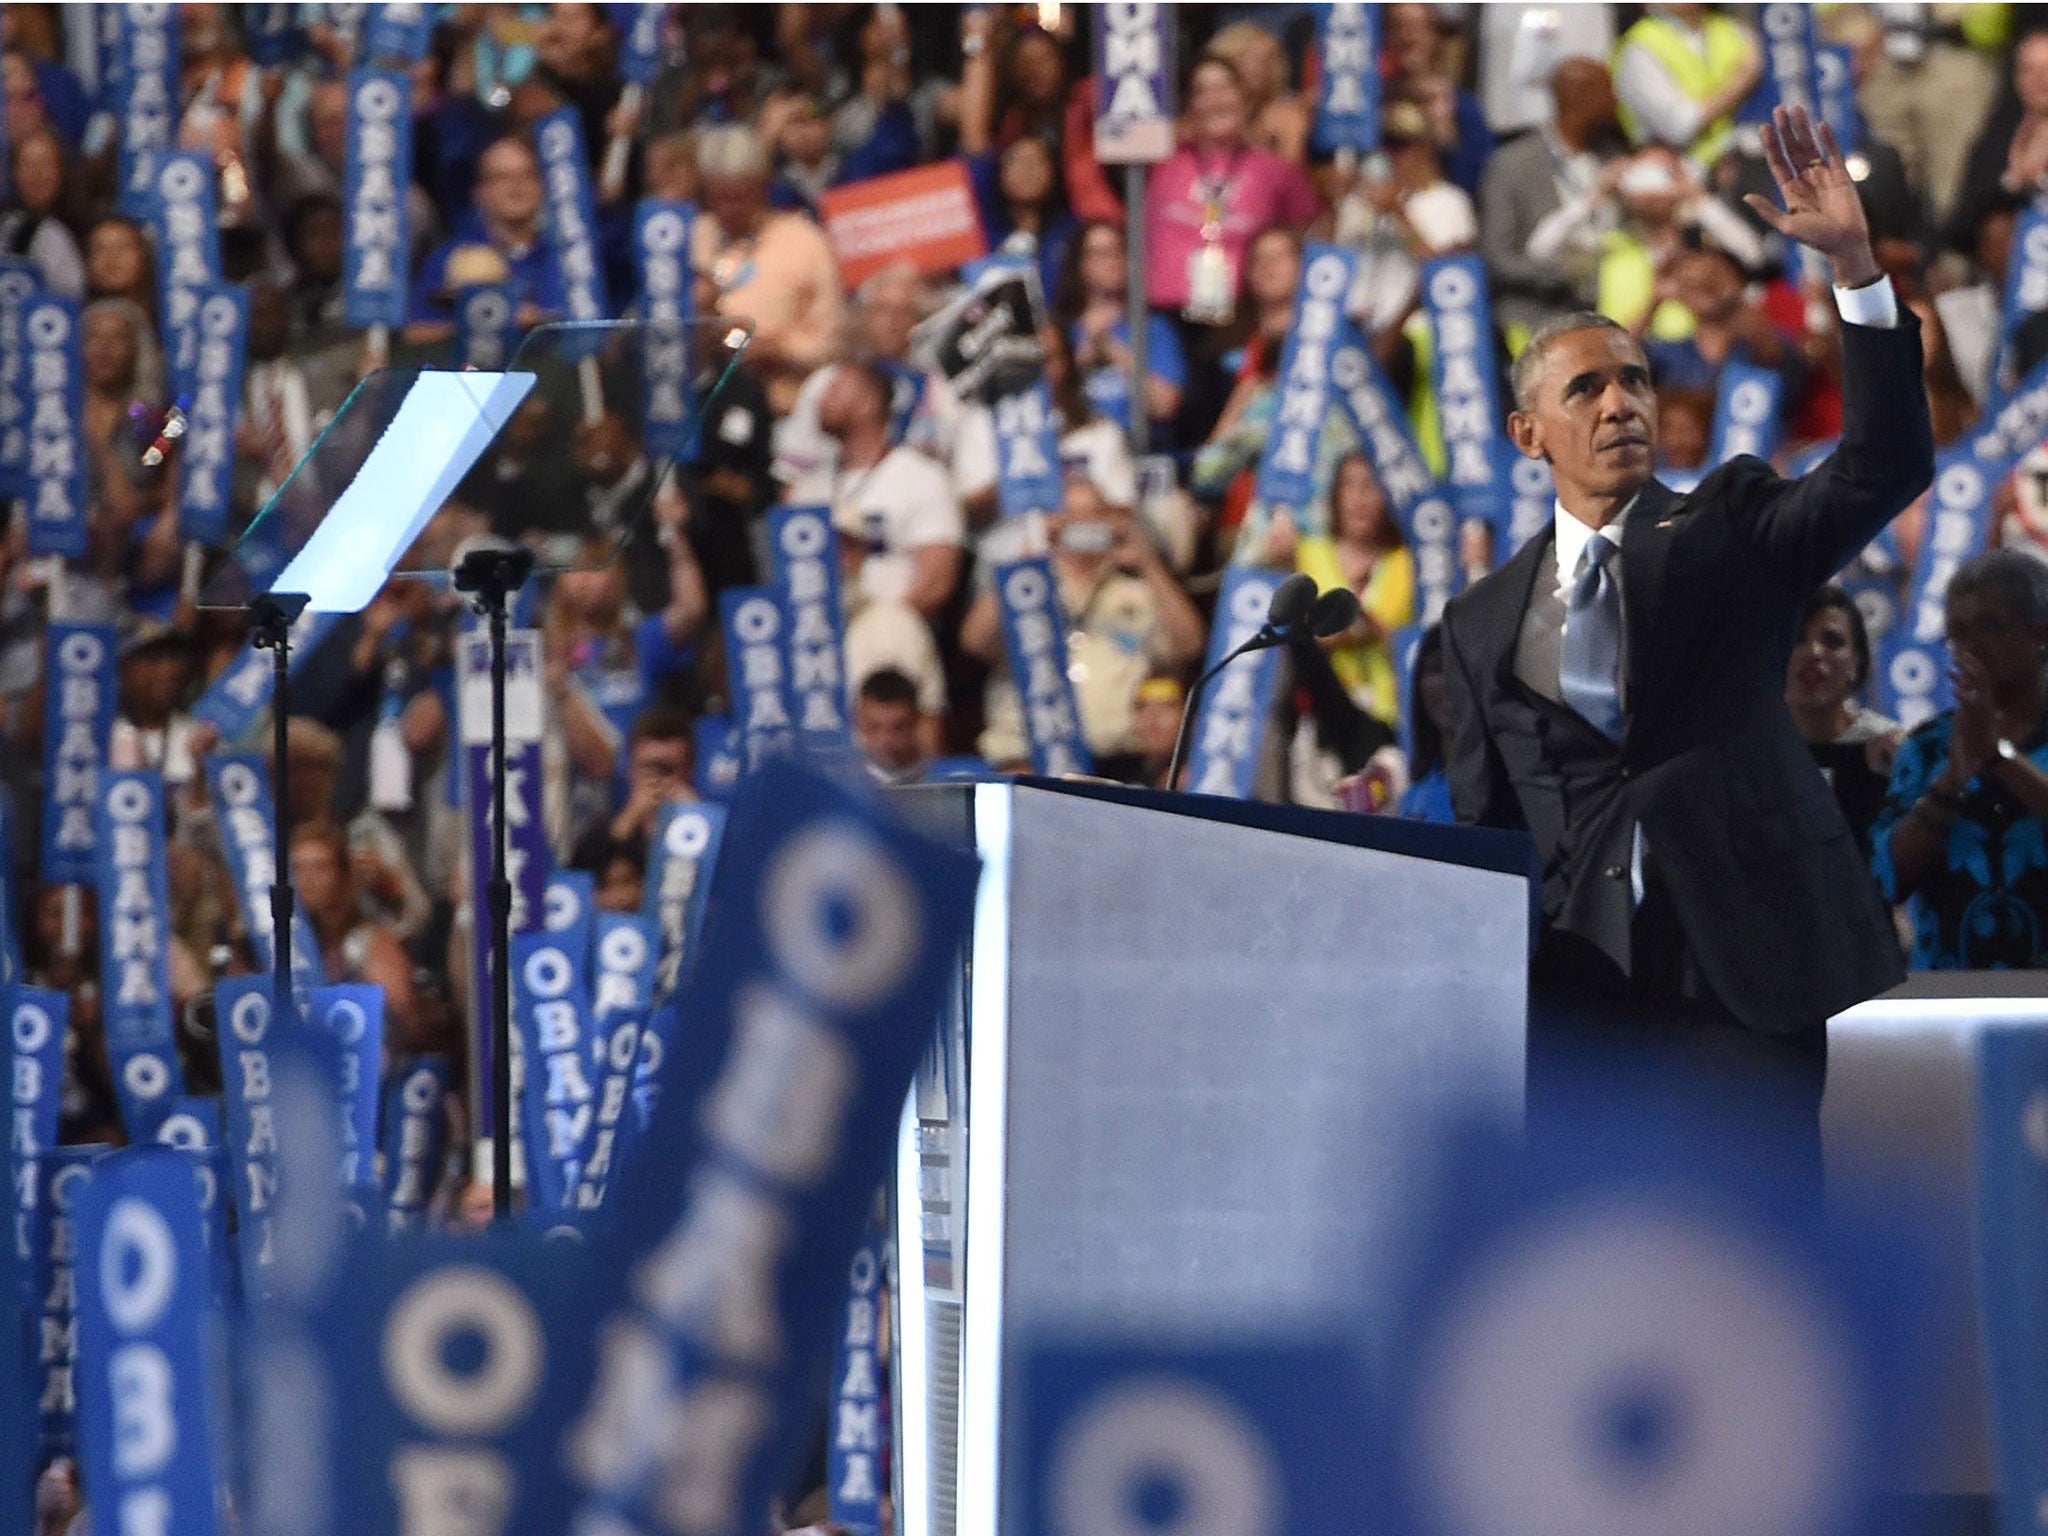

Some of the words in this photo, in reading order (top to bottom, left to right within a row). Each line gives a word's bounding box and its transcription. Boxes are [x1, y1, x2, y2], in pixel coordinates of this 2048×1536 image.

[353, 78, 402, 290] OBAMA
[27, 304, 75, 519] OBAMA
[187, 296, 238, 509] OBAMA
[1273, 254, 1348, 471] OBAMA
[1430, 266, 1495, 486] OBAMA
[780, 514, 842, 731] OBAMA
[55, 632, 104, 849] OBAMA
[107, 779, 160, 1001] OBAMA
[837, 1248, 877, 1502] OBAMA
